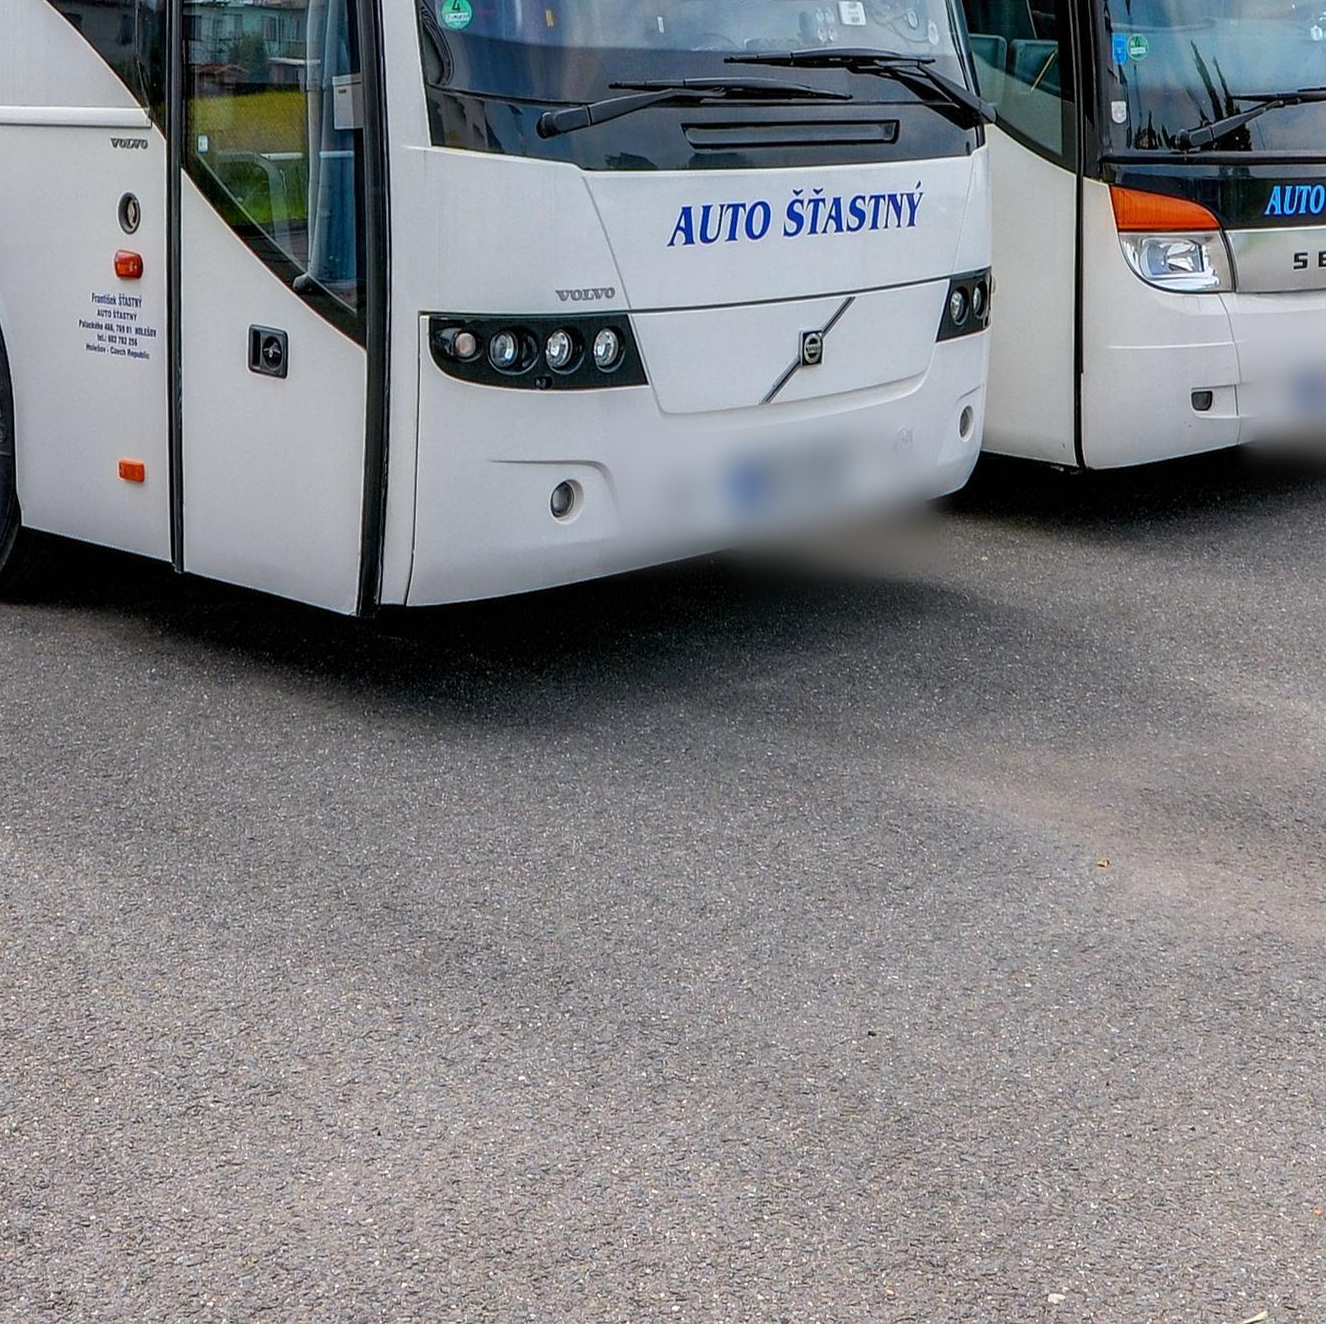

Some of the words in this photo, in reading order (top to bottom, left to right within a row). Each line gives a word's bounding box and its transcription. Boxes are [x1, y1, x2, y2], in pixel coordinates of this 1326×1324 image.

[110, 138, 148, 150] VOLVO
[1264, 184, 1325, 216] AUTO
[666, 200, 772, 247] AUTO
[783, 180, 924, 238] ŠŤASTNÝ
[555, 287, 615, 302] VOLVO
[97, 309, 112, 318] AUTO
